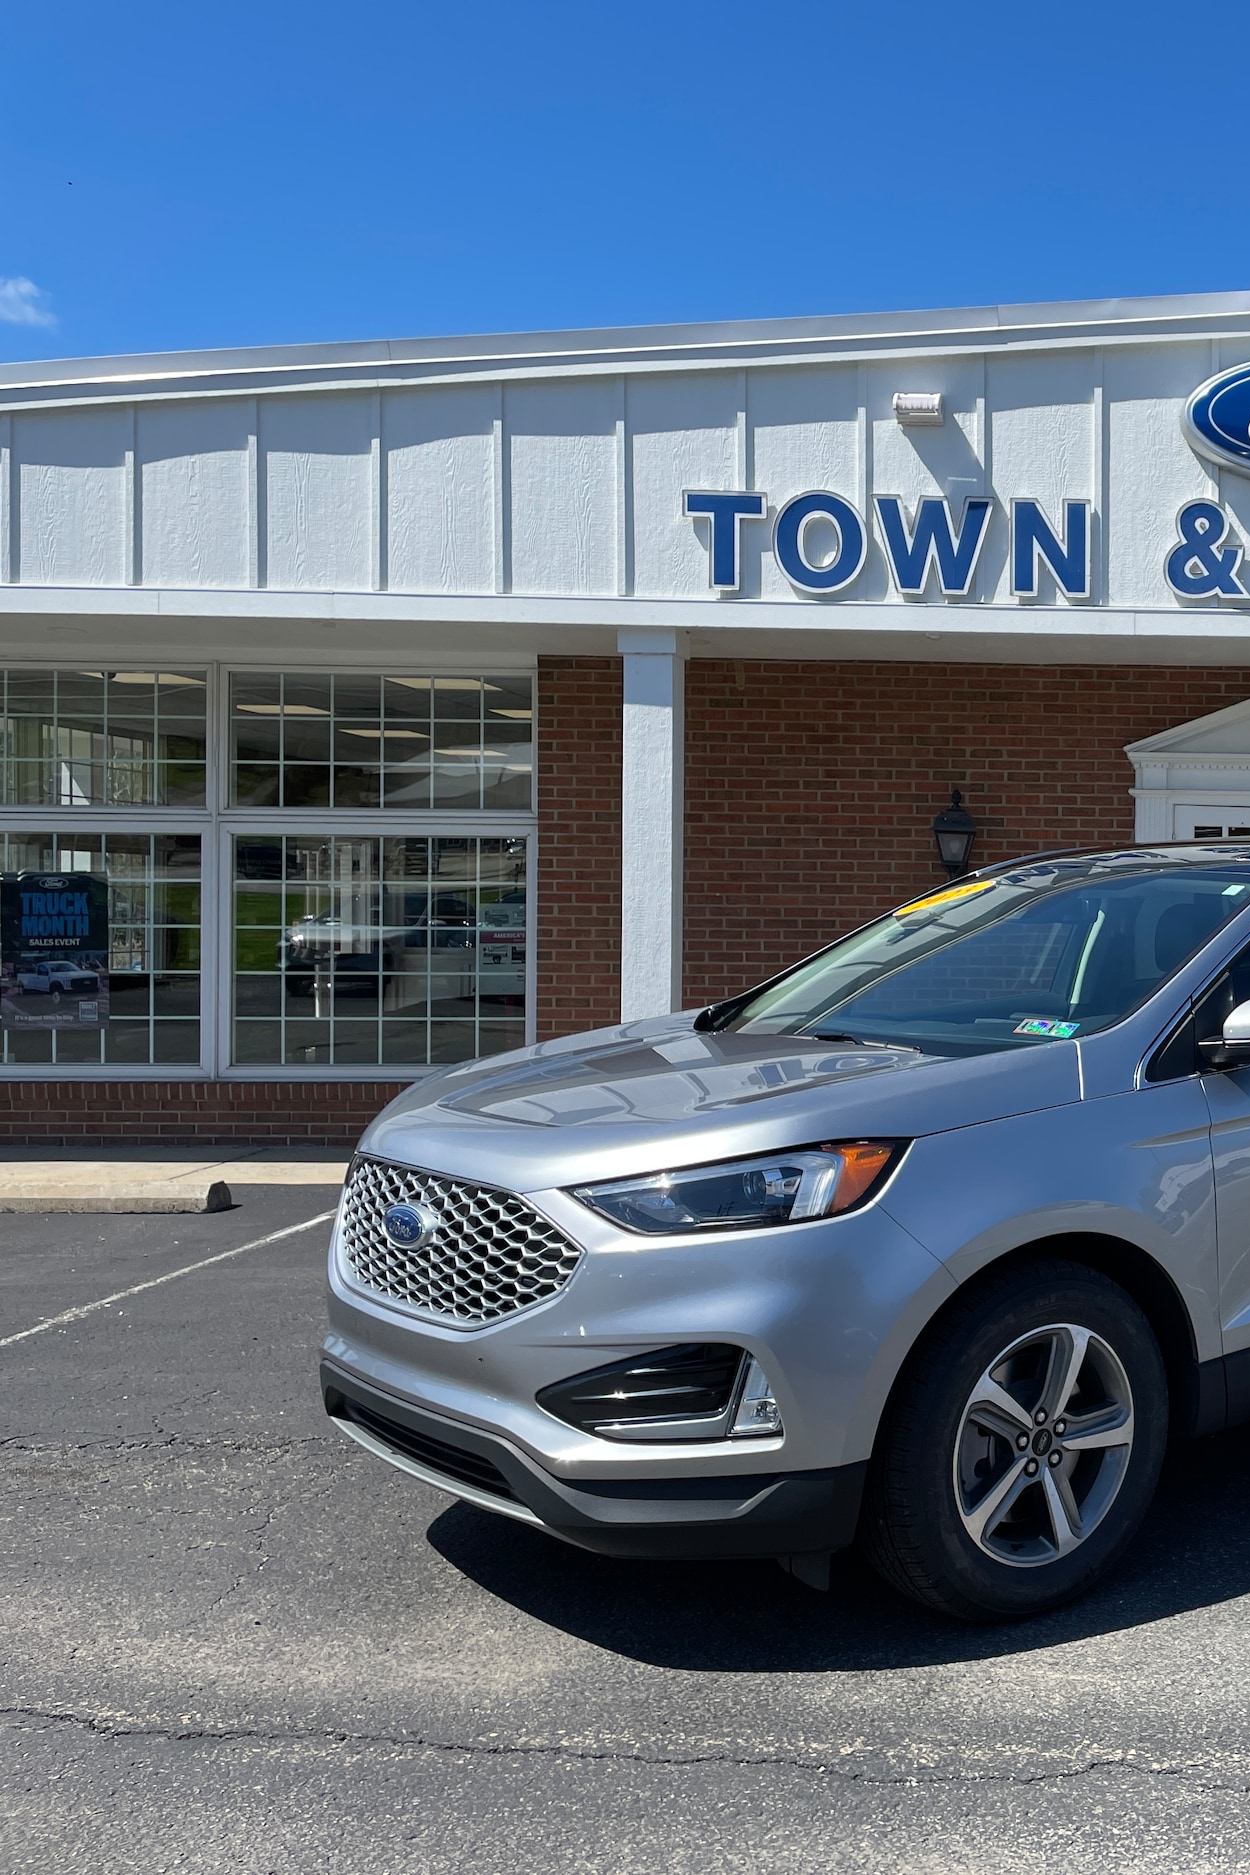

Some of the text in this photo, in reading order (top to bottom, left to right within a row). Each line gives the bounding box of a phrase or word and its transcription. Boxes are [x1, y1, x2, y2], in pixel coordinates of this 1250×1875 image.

[682, 489, 1091, 598] TOWN
[20, 892, 89, 915] TRUCK
[21, 915, 89, 937] MONTH
[29, 938, 80, 946] SALES EVENT
